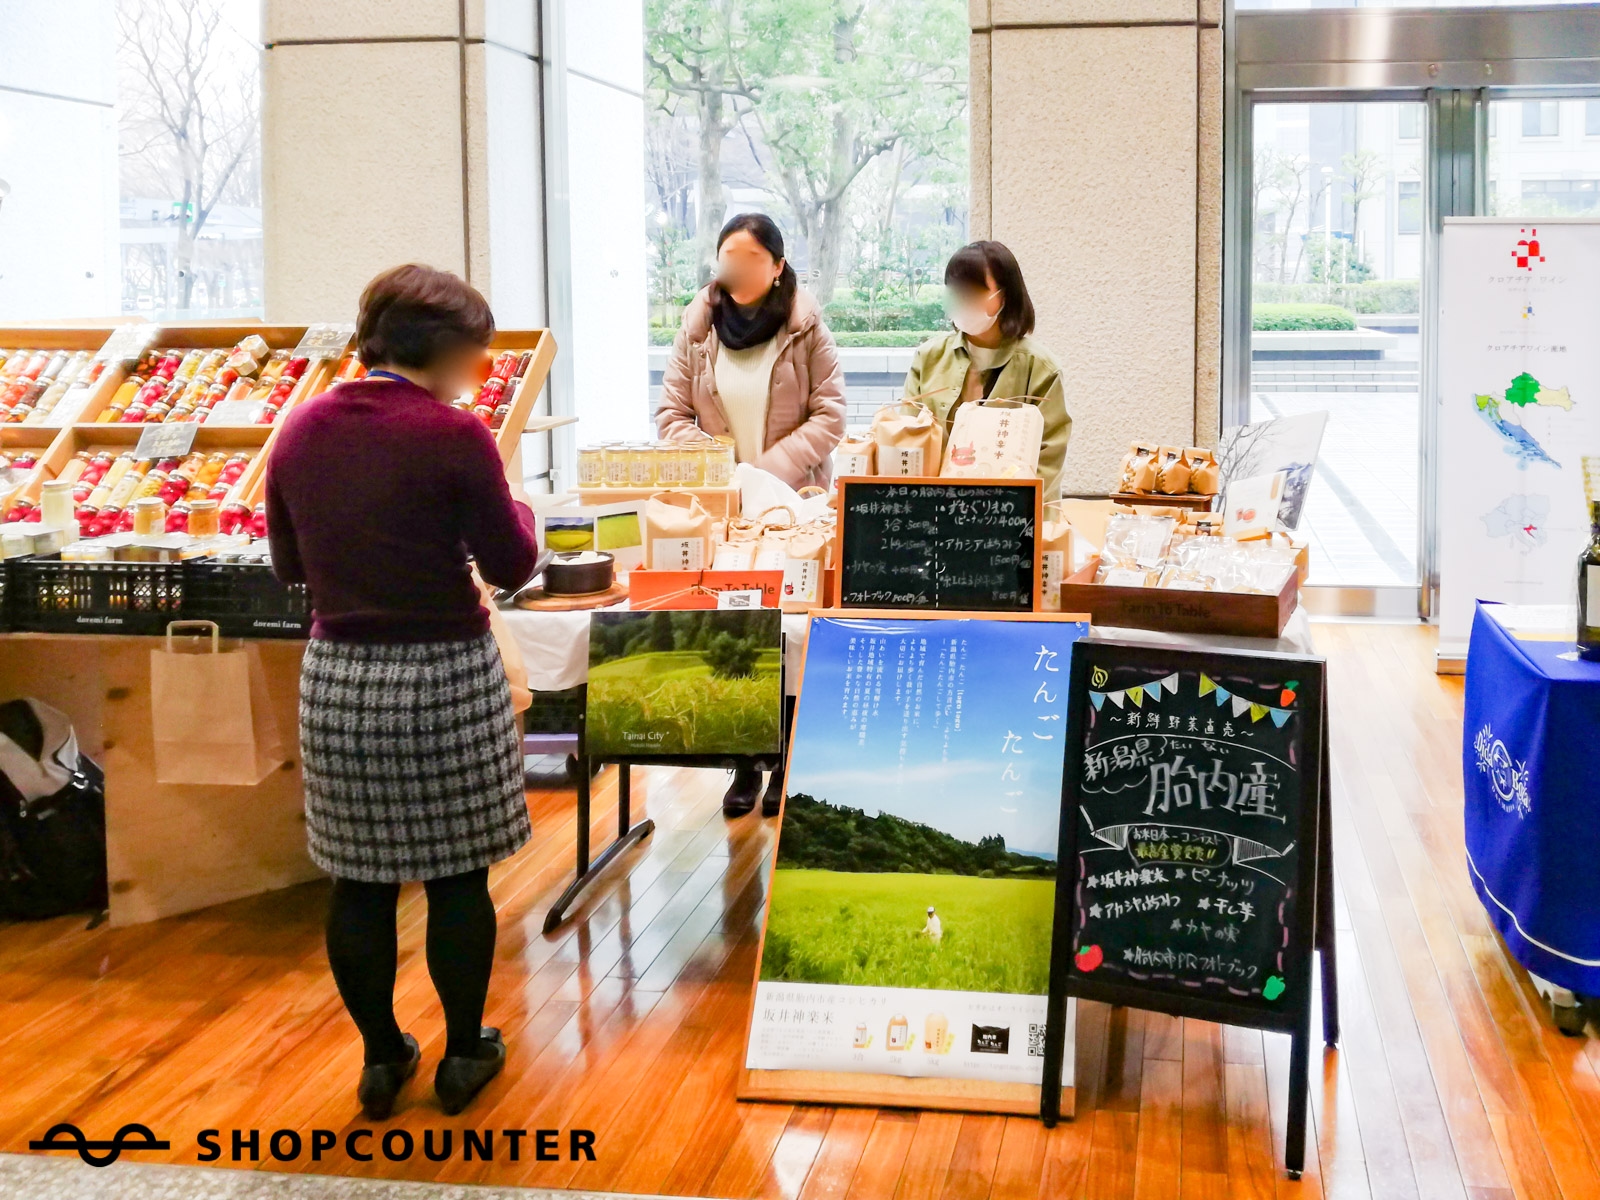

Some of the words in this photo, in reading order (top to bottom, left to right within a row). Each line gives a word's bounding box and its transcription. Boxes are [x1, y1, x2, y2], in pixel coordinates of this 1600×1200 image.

[76, 615, 103, 624] doremi
[104, 615, 123, 624] farm
[253, 619, 281, 628] doremi
[282, 620, 301, 629] farm
[1032, 644, 1061, 741] たんご
[648, 731, 665, 742] City
[1000, 729, 1023, 814] たんご
[1083, 738, 1154, 782] 新潟県
[1142, 755, 1286, 824] 胎内産
[763, 1008, 834, 1025] 坂井神楽米
